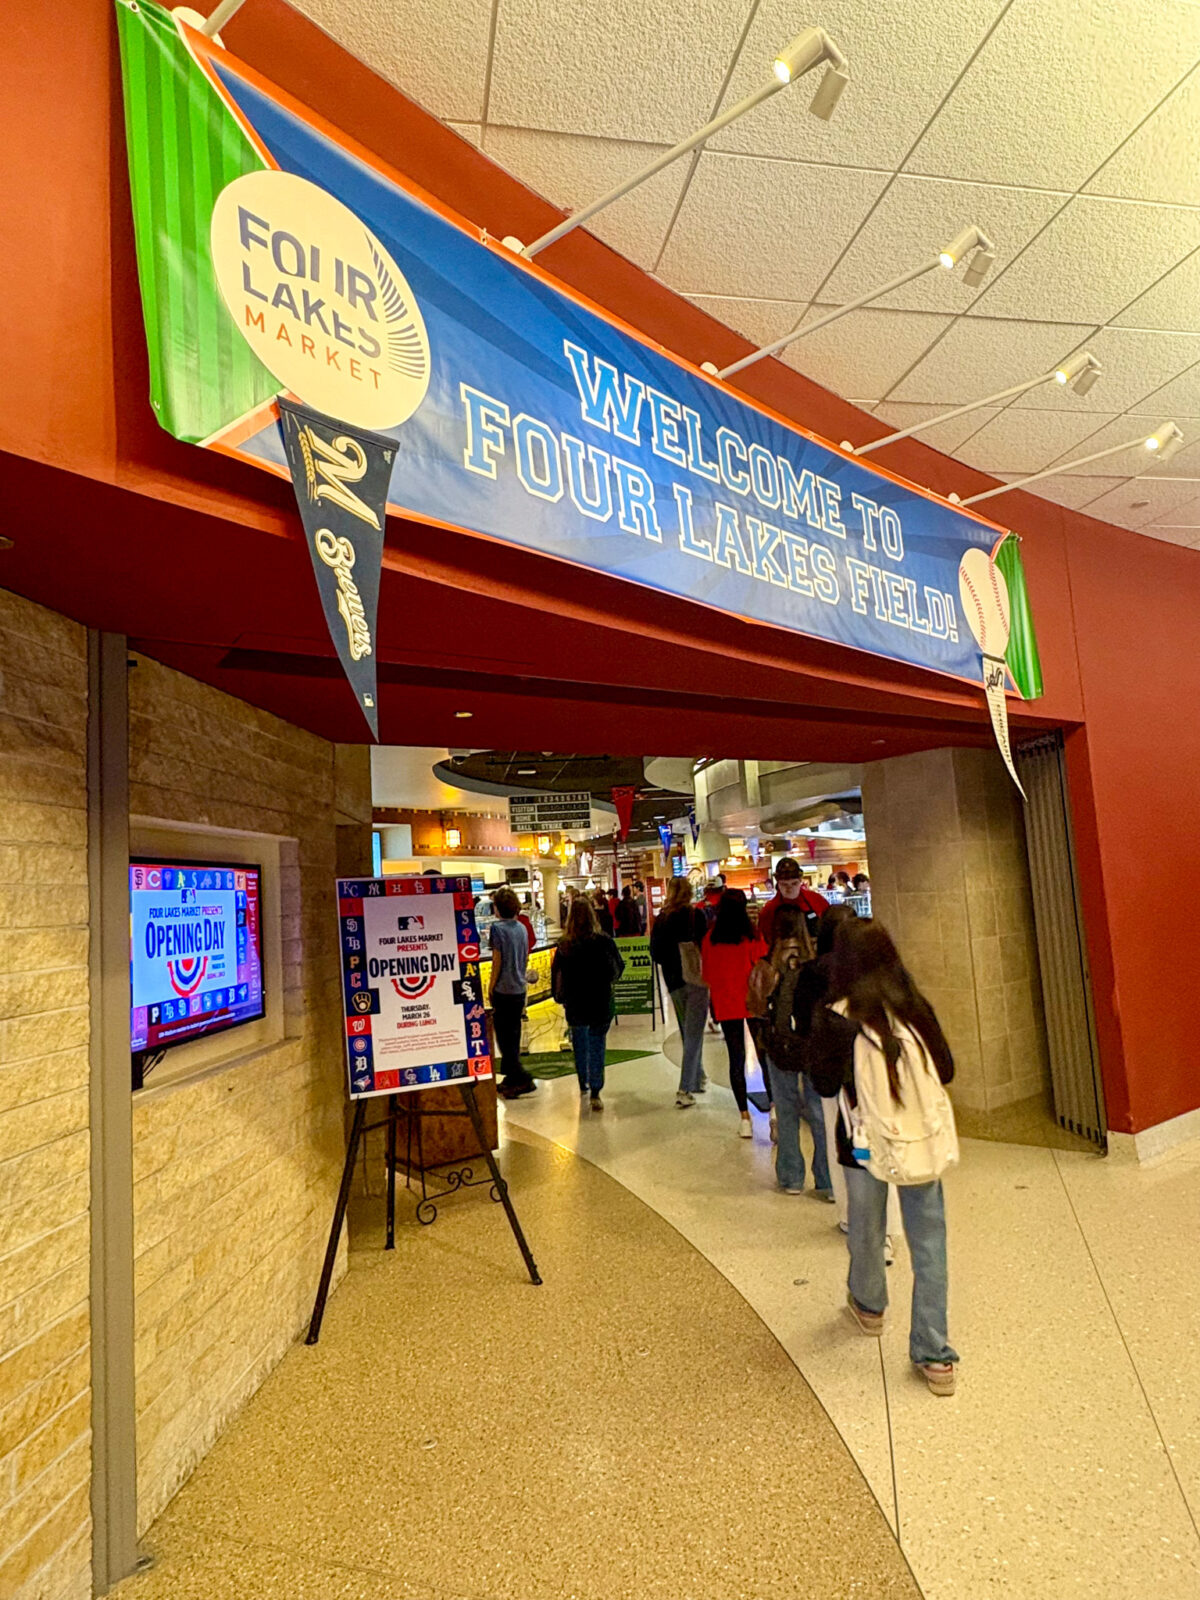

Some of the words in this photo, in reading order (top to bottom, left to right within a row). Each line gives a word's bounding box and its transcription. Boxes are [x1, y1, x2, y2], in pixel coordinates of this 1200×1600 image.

[242, 260, 382, 358] LAKES
[245, 304, 381, 390] MARKET
[563, 339, 847, 540] WELCOME
[851, 492, 904, 562] TO
[459, 382, 663, 544] FOUR
[672, 482, 840, 605] LAKES
[846, 556, 959, 643] FIELD!
[315, 528, 373, 661] Brewers
[541, 822, 563, 830] STRIKE
[149, 908, 164, 918] FOUR
[165, 907, 181, 918] LAKES
[181, 907, 200, 917] MARKET
[145, 922, 202, 959] OPENING
[204, 918, 226, 951] DAY
[379, 936, 396, 946] FOUR
[397, 934, 417, 944] LAKES
[418, 933, 443, 942] MARKET
[397, 943, 428, 953] PRESENTS
[369, 955, 429, 979] OPENING
[430, 953, 456, 972] DAY
[396, 1021, 419, 1029] DURING
[419, 1018, 437, 1027] LUNCH
[402, 1012, 422, 1020] MARCH
[423, 1011, 431, 1019] 26
